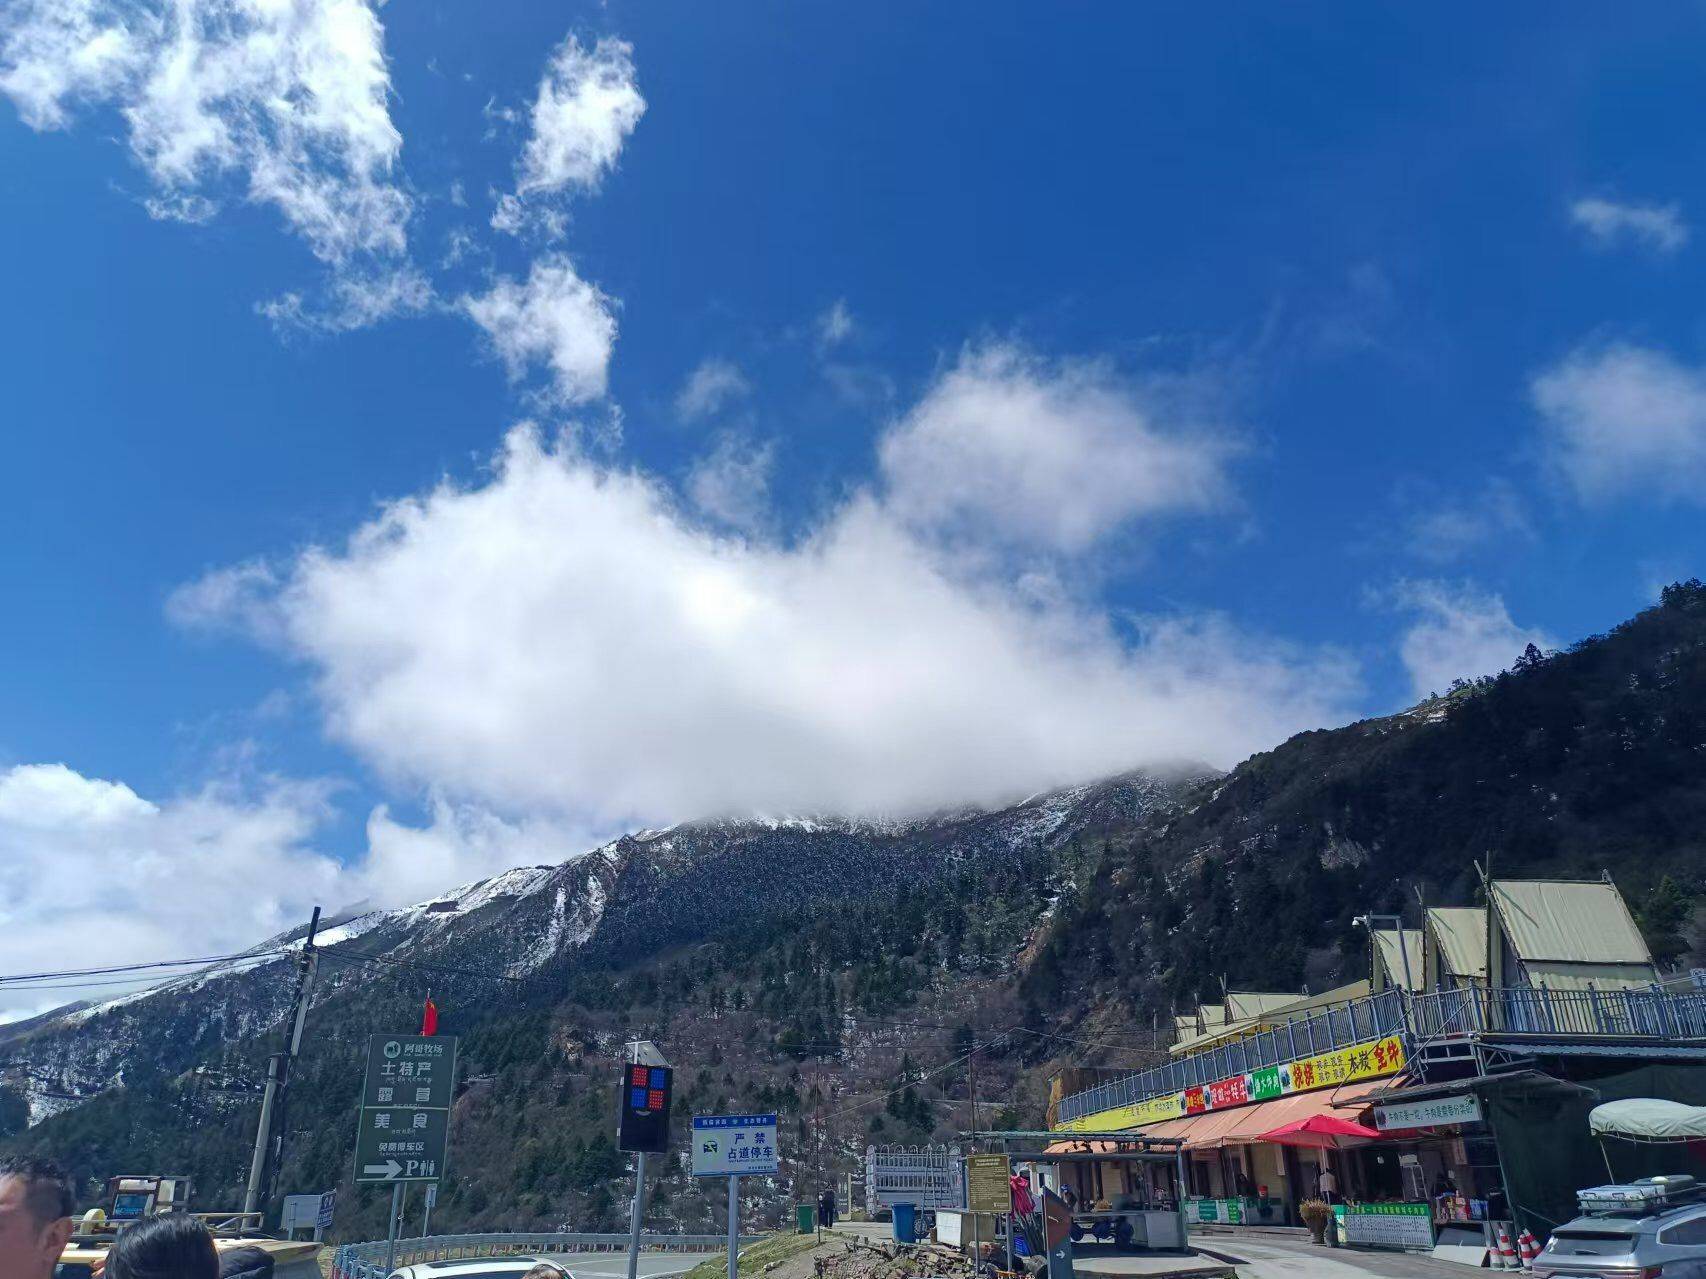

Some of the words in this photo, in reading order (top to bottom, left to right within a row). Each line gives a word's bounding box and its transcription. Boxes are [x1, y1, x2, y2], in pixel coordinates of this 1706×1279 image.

[380, 1061, 432, 1076] 土特产
[374, 1113, 428, 1128] 美食
[734, 1132, 766, 1144] 严禁
[728, 1146, 773, 1159] 占道停车
[405, 1160, 419, 1176] P
